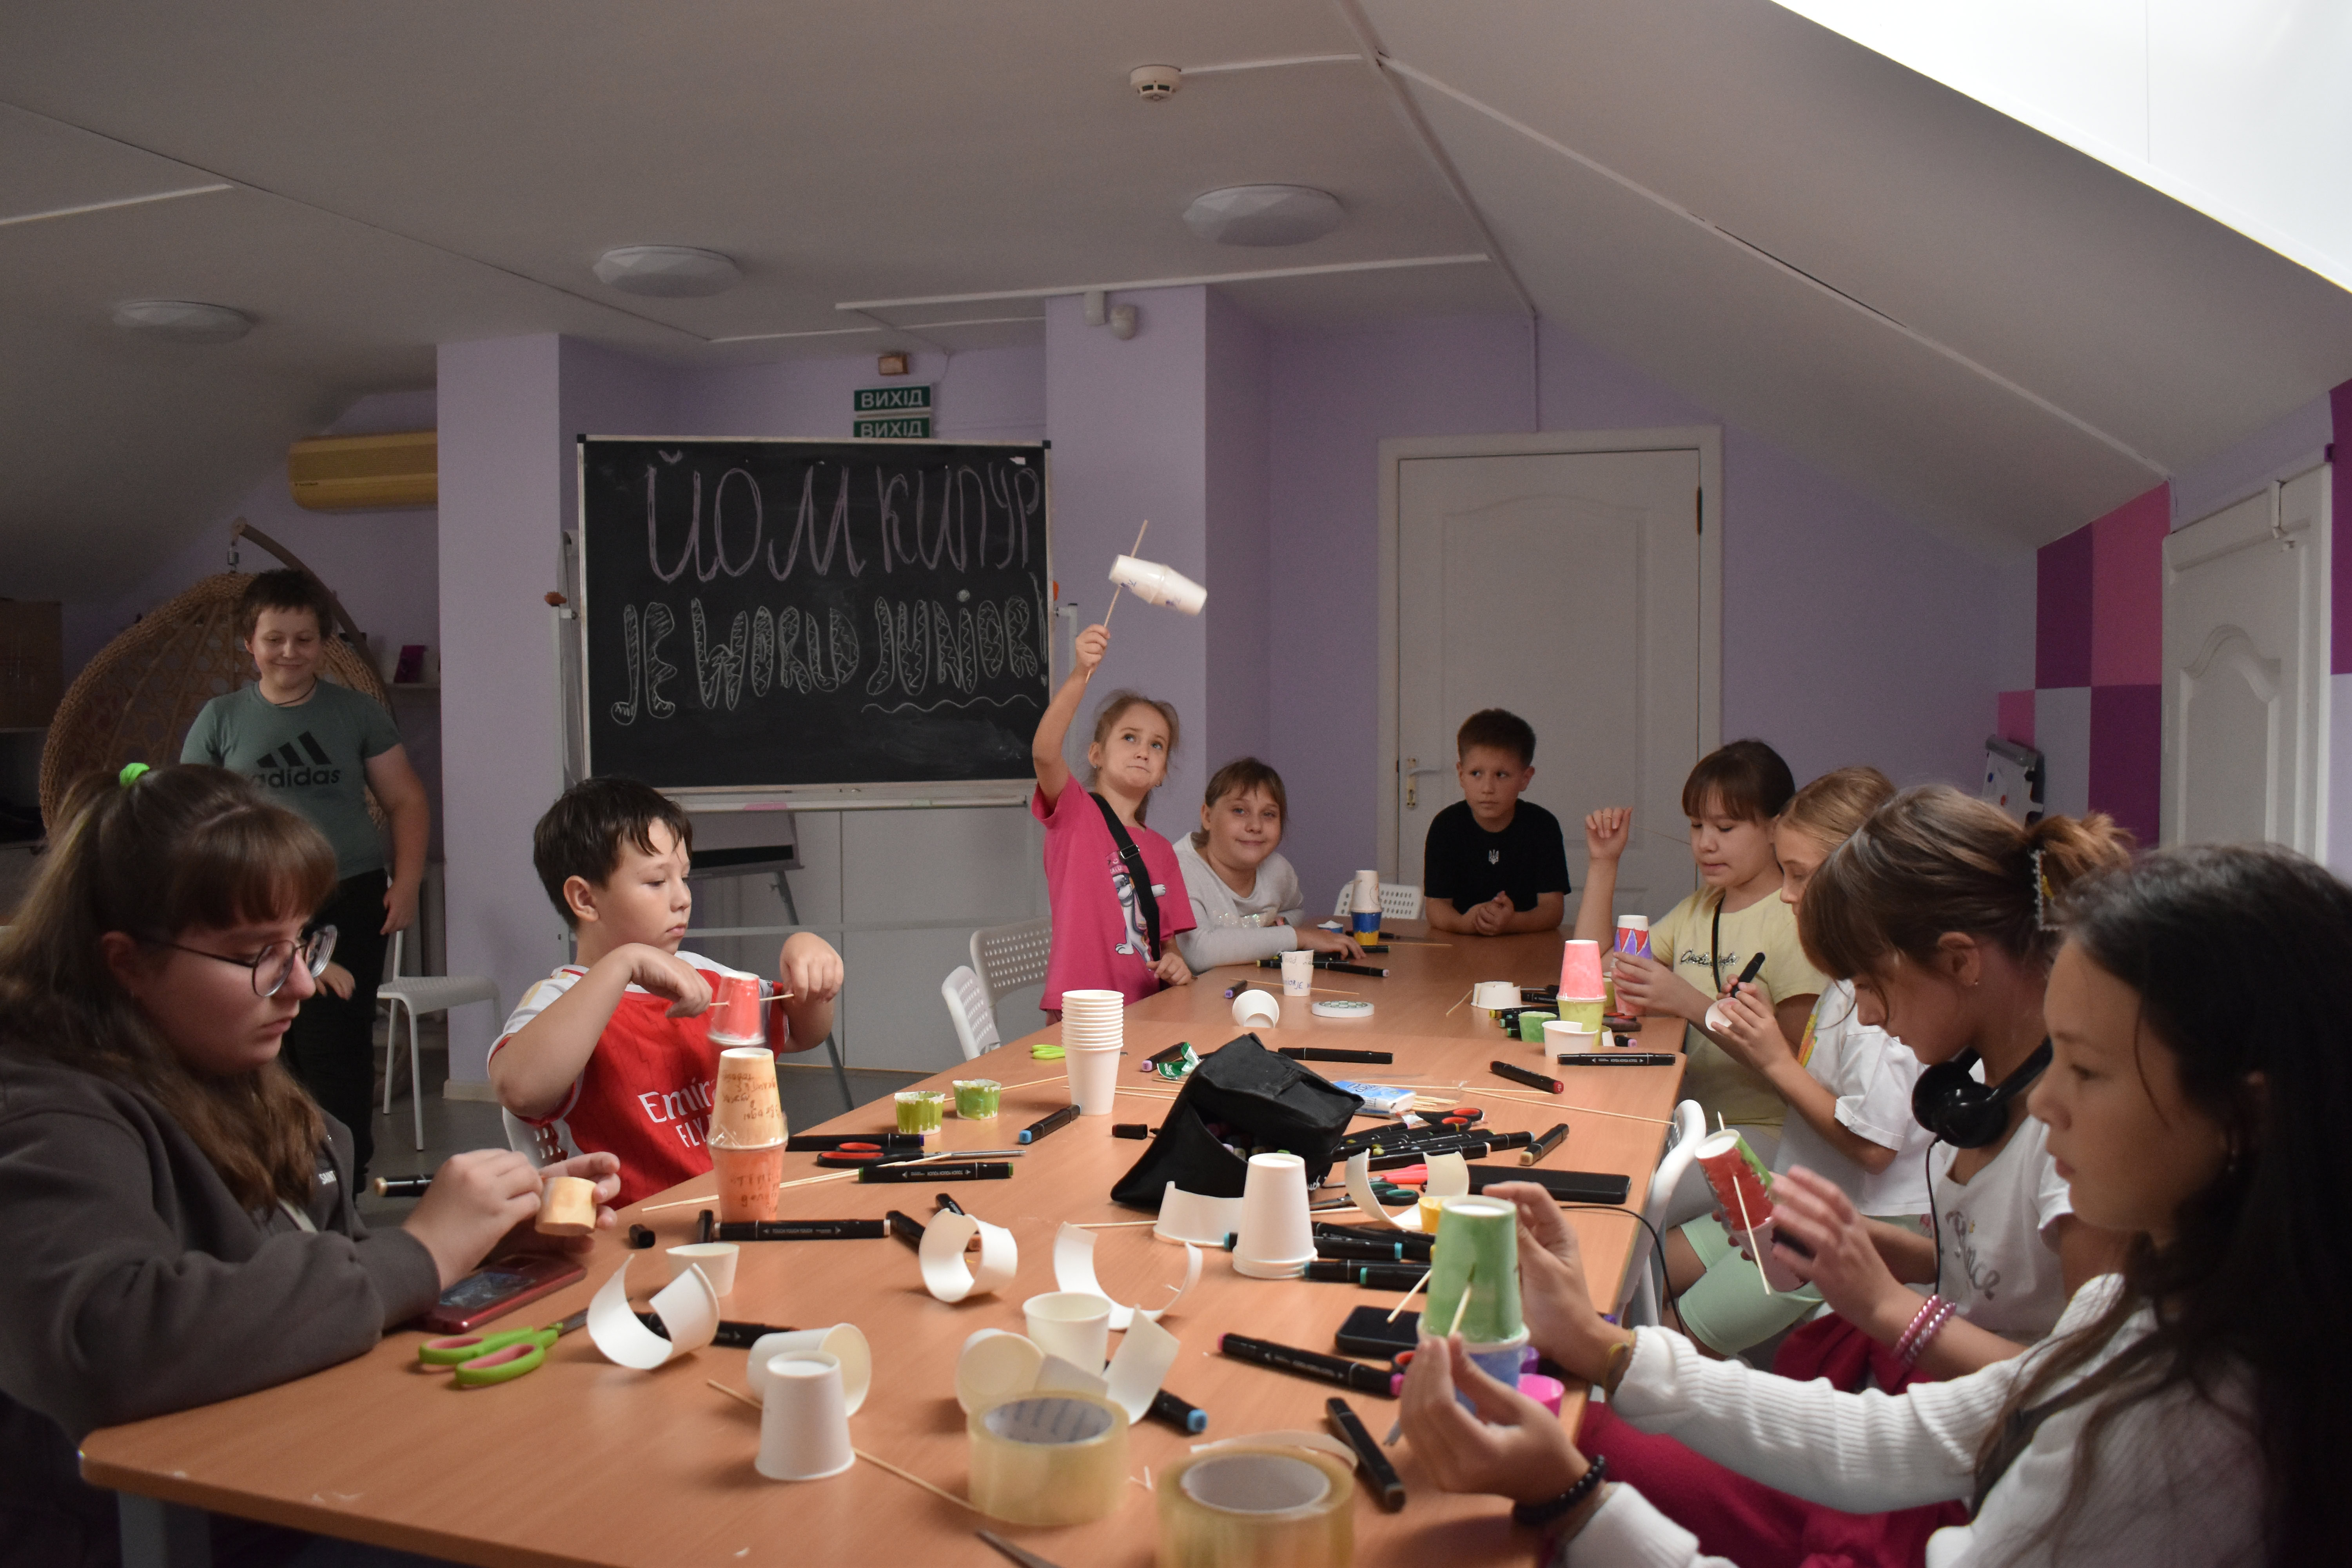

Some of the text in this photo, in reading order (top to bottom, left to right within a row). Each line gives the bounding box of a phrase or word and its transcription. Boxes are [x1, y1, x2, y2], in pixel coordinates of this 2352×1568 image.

[861, 389, 923, 408] ВИХІД
[860, 420, 922, 437] ВИХІД
[637, 1077, 717, 1123] Emir
